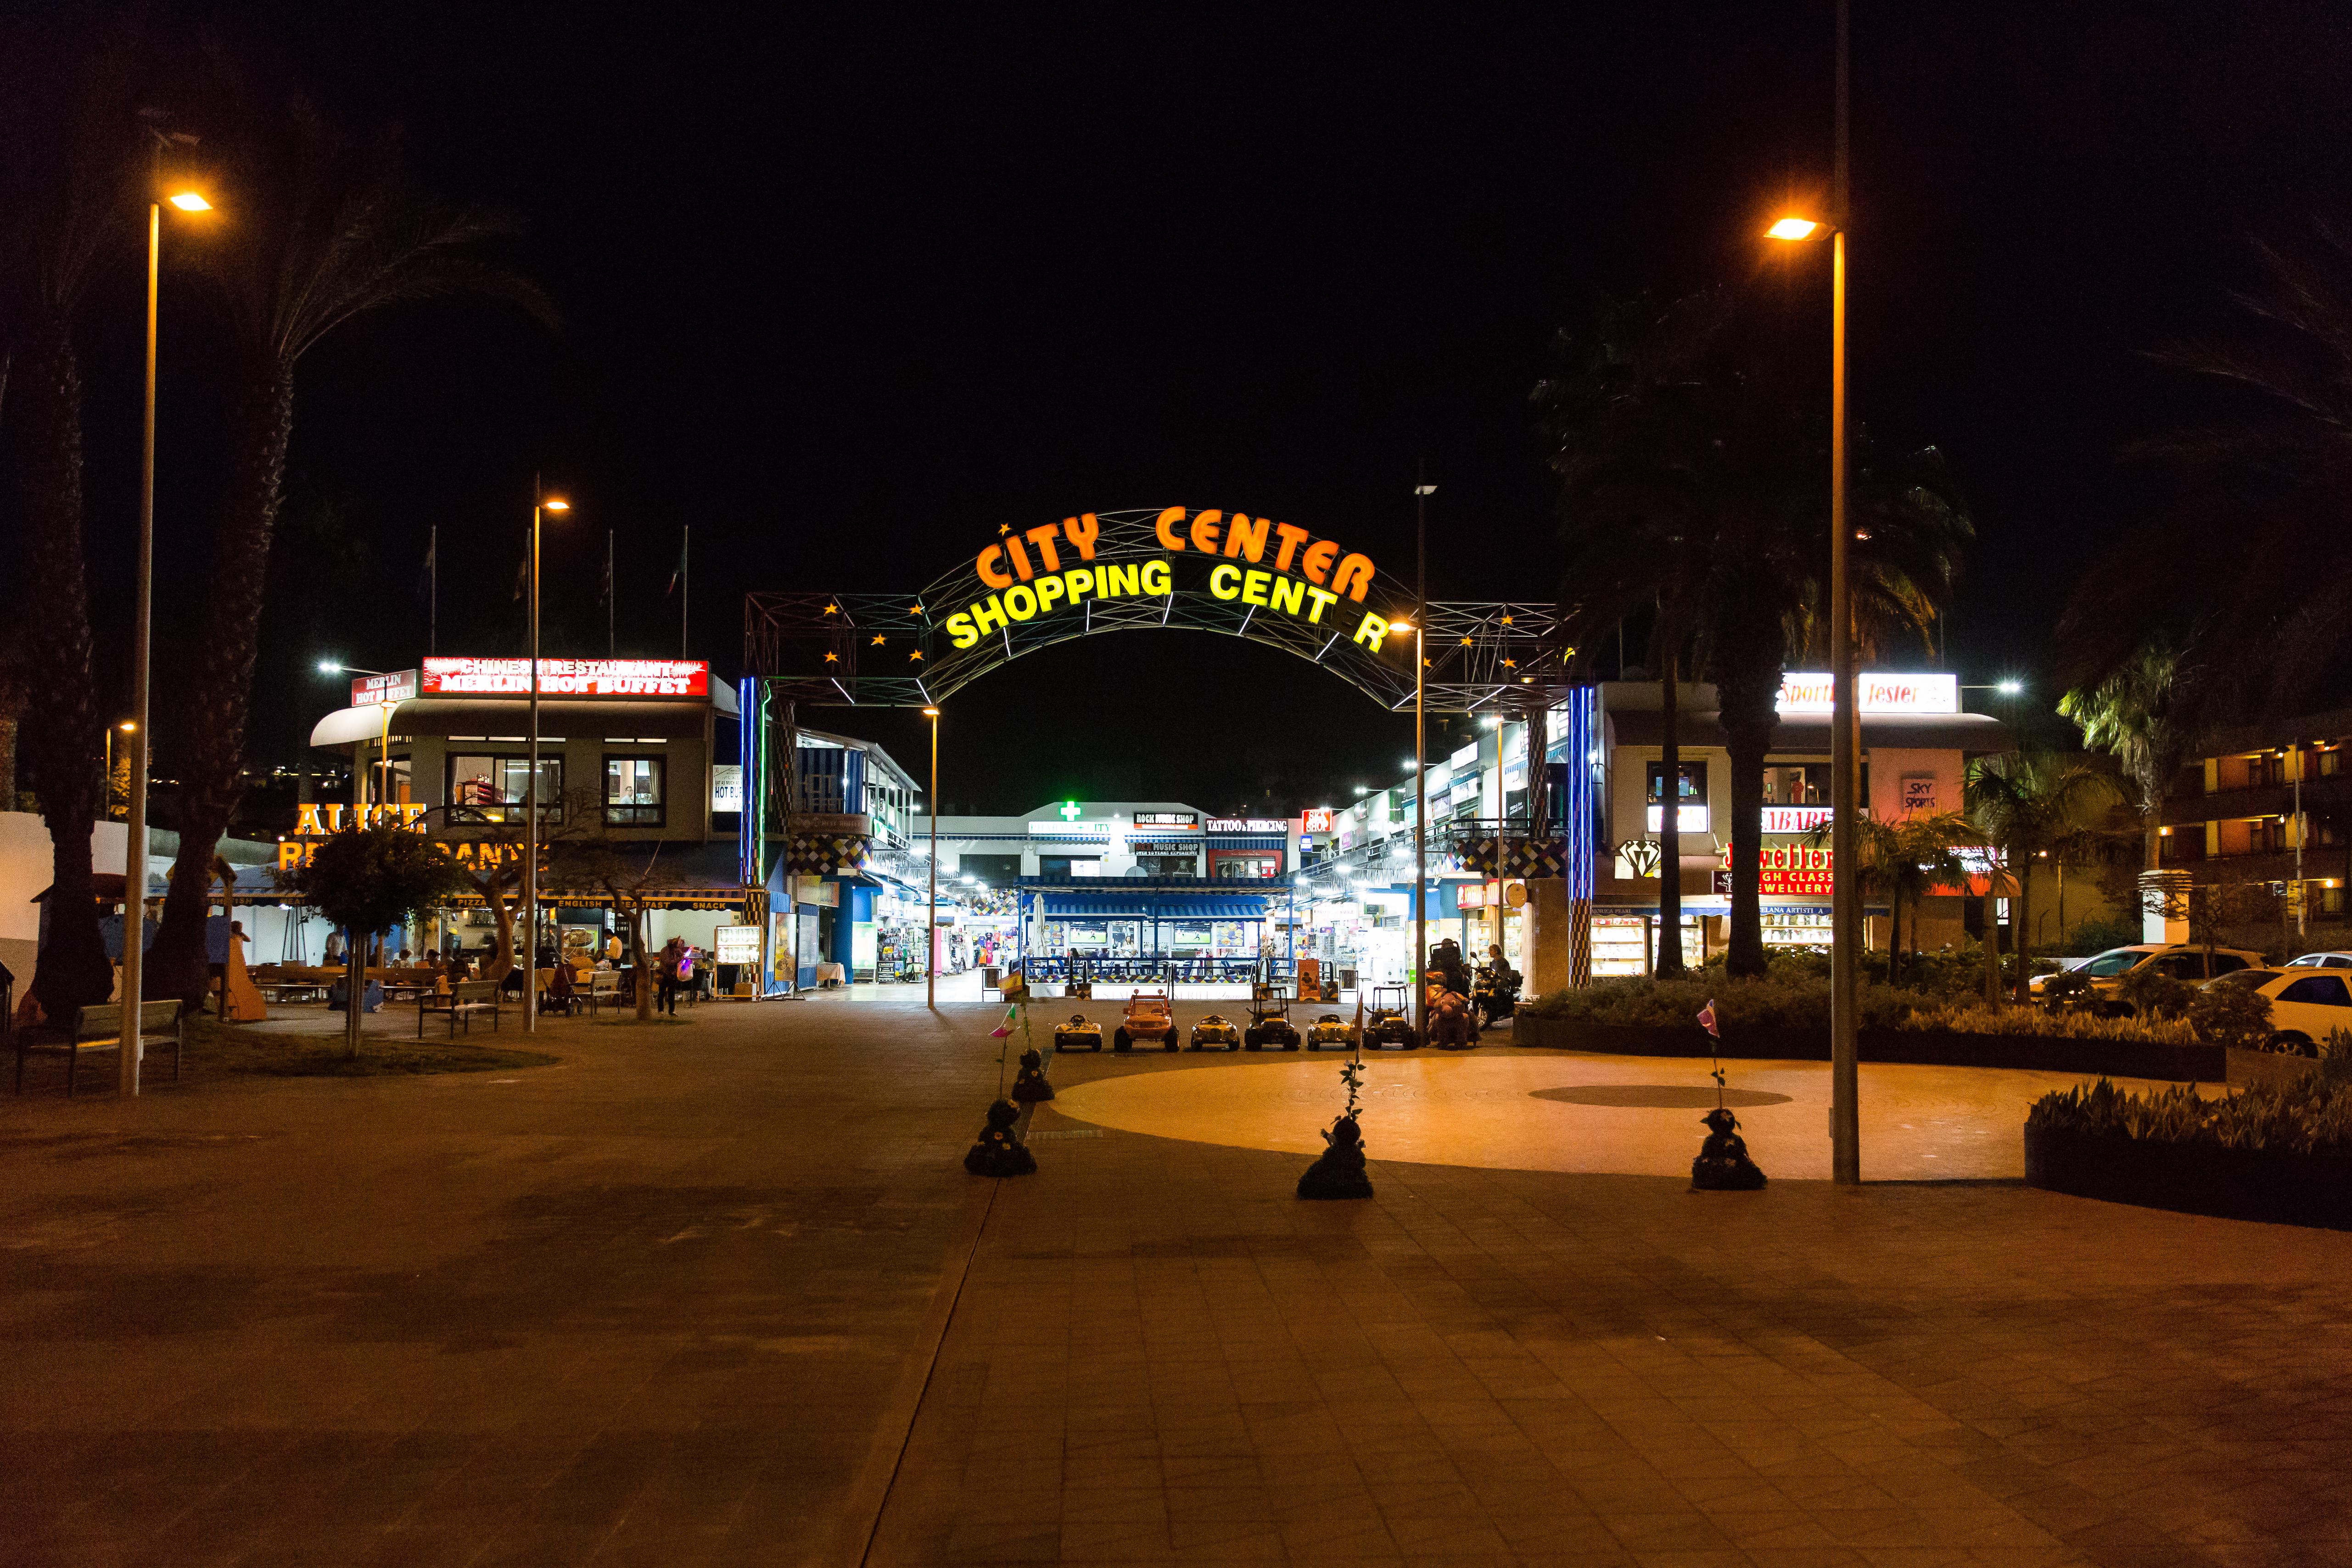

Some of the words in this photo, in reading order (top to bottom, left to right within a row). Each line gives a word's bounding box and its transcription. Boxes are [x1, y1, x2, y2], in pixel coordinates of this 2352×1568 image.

[976, 512, 1099, 588] CITY
[1156, 506, 1375, 603] CENTER
[946, 560, 1171, 649] SHOPPING
[366, 674, 402, 689] MERLIN
[440, 675, 532, 691] MERLIN
[540, 676, 588, 693] HOT
[598, 677, 691, 694] BUFFET
[356, 690, 375, 704] HOT
[1867, 683, 1921, 706] Jester
[715, 786, 728, 798] HOT
[730, 787, 742, 798] BUF
[1907, 783, 1932, 794] SKY
[1905, 797, 1936, 808] SPORTS
[294, 803, 427, 835] ALICE
[1137, 814, 1154, 823] ROCK
[1176, 814, 1194, 823] SHOP
[1309, 811, 1326, 821] SEX
[1762, 812, 1833, 830] ABARE
[1207, 820, 1242, 832] TATTOO
[1246, 820, 1287, 832] PIERCING
[1306, 820, 1328, 832] SHOP
[1762, 873, 1781, 881] GH
[1789, 873, 1833, 882] CLASS
[1758, 884, 1832, 893] EWELLERY
